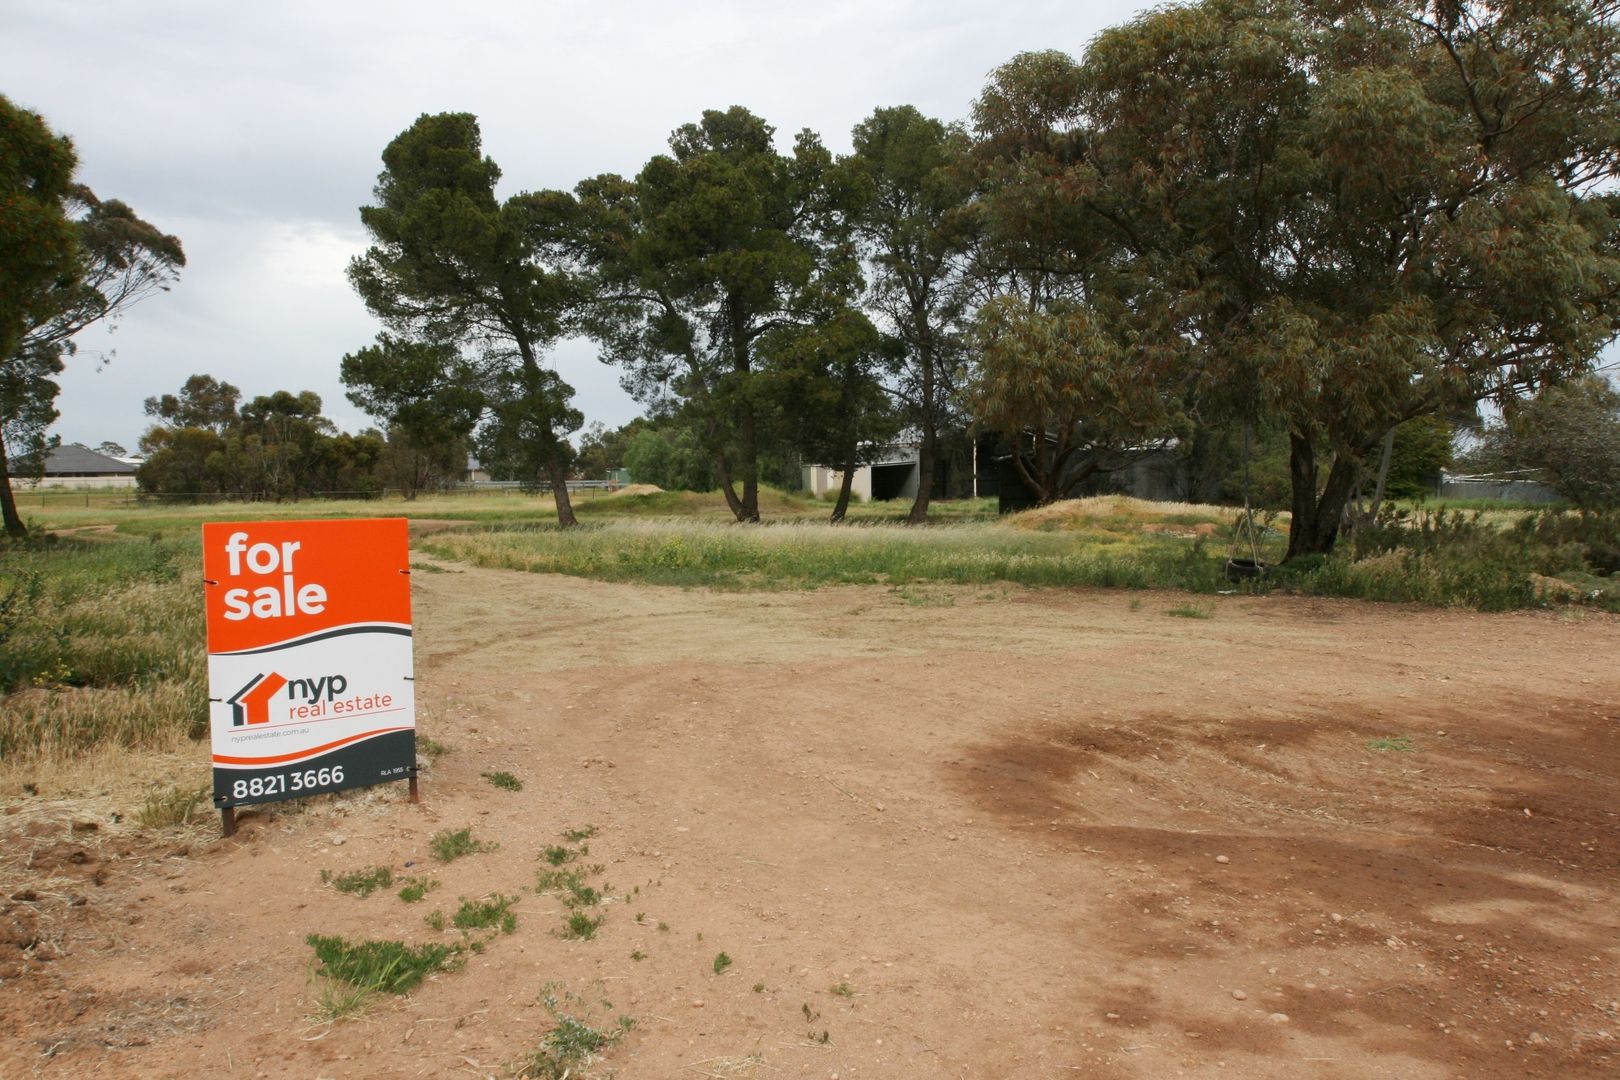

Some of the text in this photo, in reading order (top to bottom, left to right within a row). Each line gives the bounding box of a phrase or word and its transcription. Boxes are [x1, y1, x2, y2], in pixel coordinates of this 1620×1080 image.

[225, 532, 301, 576] for
[223, 574, 328, 621] sale
[288, 674, 348, 705] nyp
[289, 693, 393, 719] real estate
[231, 727, 310, 743] nyprealestate.com.au
[233, 765, 345, 799] 8821 3666
